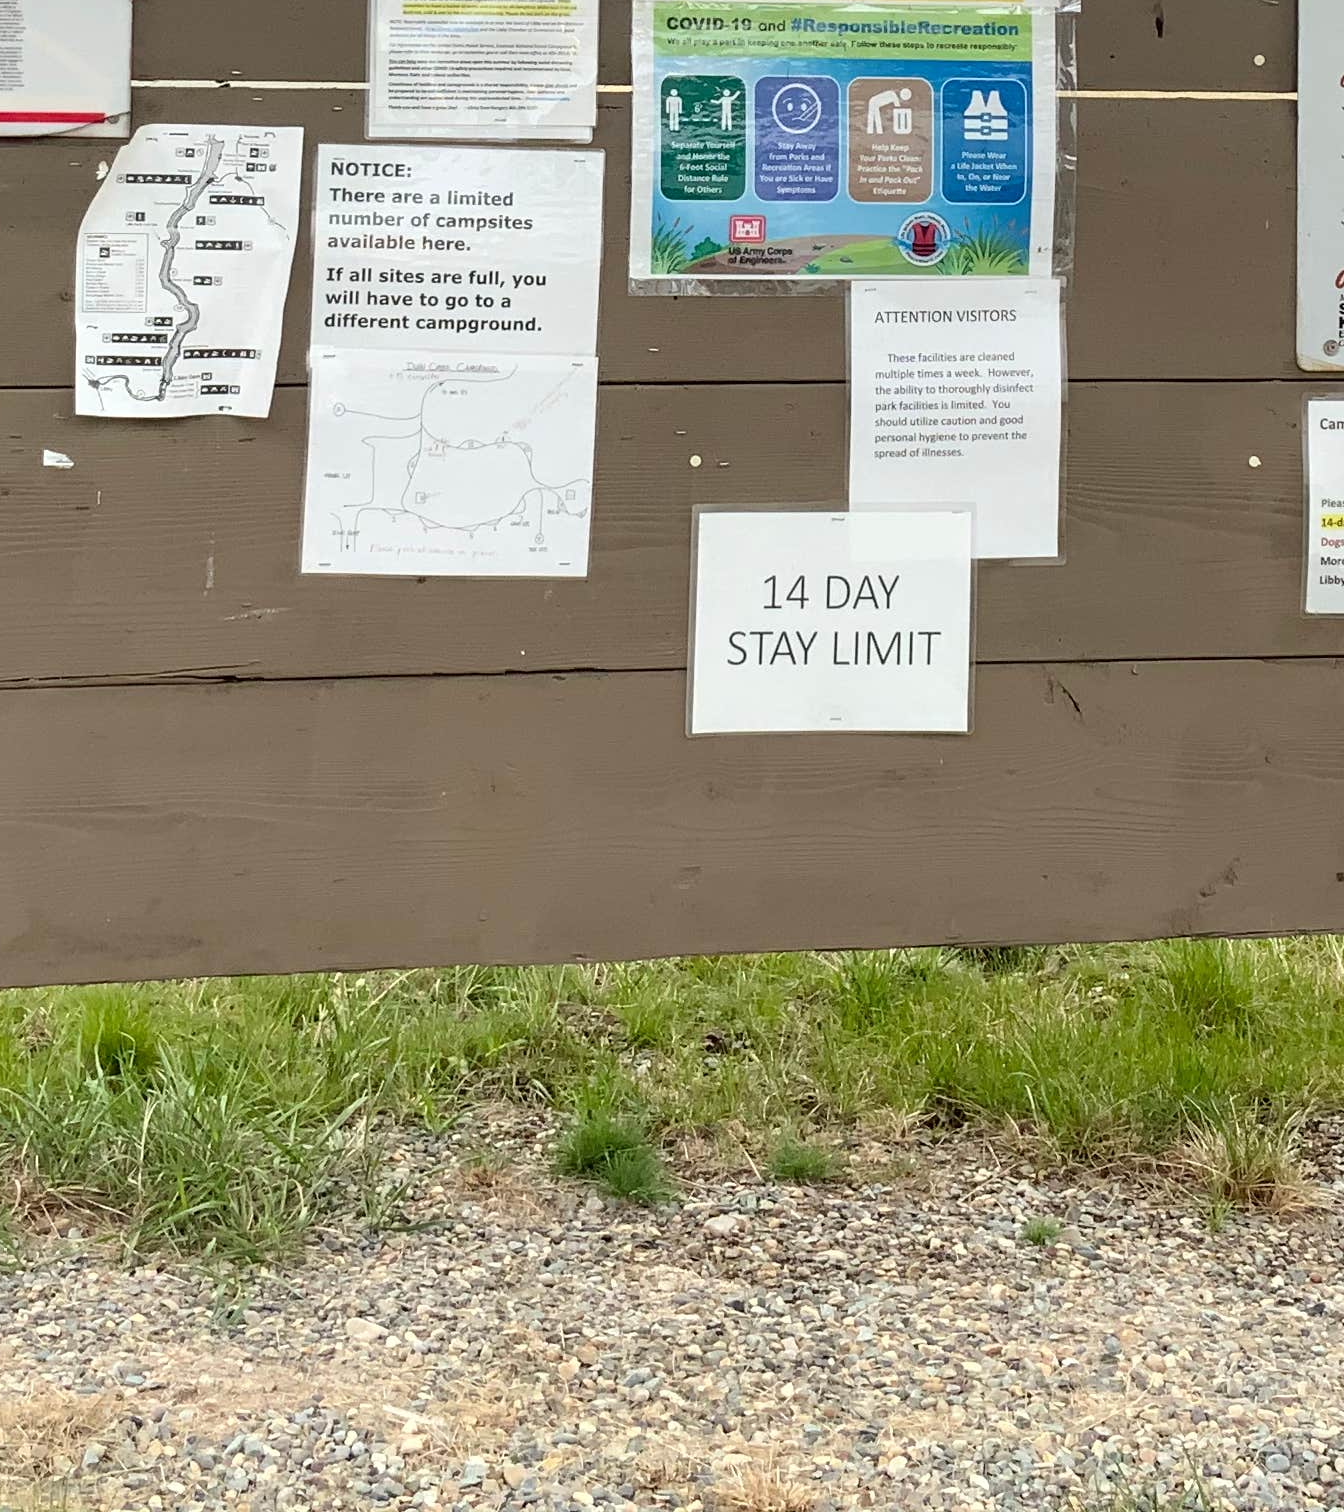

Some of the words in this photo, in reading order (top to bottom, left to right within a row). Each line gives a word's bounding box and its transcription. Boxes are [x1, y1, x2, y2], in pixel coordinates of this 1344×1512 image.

[666, 16, 752, 30] COVID-19
[757, 19, 786, 32] and
[790, 17, 1018, 36] #ResponsibleRecreation
[331, 162, 411, 177] NOTICE:
[329, 187, 385, 203] There
[391, 192, 423, 204] are
[429, 193, 439, 204] a
[447, 190, 513, 206] limited
[329, 211, 404, 226] number
[410, 212, 430, 227] of
[435, 214, 533, 232] campsites
[327, 234, 415, 249] available
[422, 235, 470, 251] here.
[326, 267, 343, 281] If
[349, 267, 372, 282] all
[378, 268, 424, 283] sites
[431, 272, 462, 284] are
[468, 270, 505, 288] full,
[512, 274, 546, 289] you
[325, 290, 359, 304] will
[367, 290, 412, 306] have
[419, 293, 438, 307] to
[445, 296, 468, 310] go
[475, 294, 494, 308] to
[500, 297, 511, 308] a
[324, 313, 409, 329] different
[415, 317, 541, 333] campground.
[874, 310, 952, 323] ATTENTION
[956, 309, 1016, 322] VISITORS
[887, 353, 916, 363] These
[917, 352, 957, 362] facilities
[959, 354, 976, 362] are
[977, 351, 1015, 361] cleaned
[763, 575, 809, 609] 14
[826, 574, 899, 609] DAY
[727, 631, 817, 665] STAY
[833, 631, 941, 665] LIMIT
